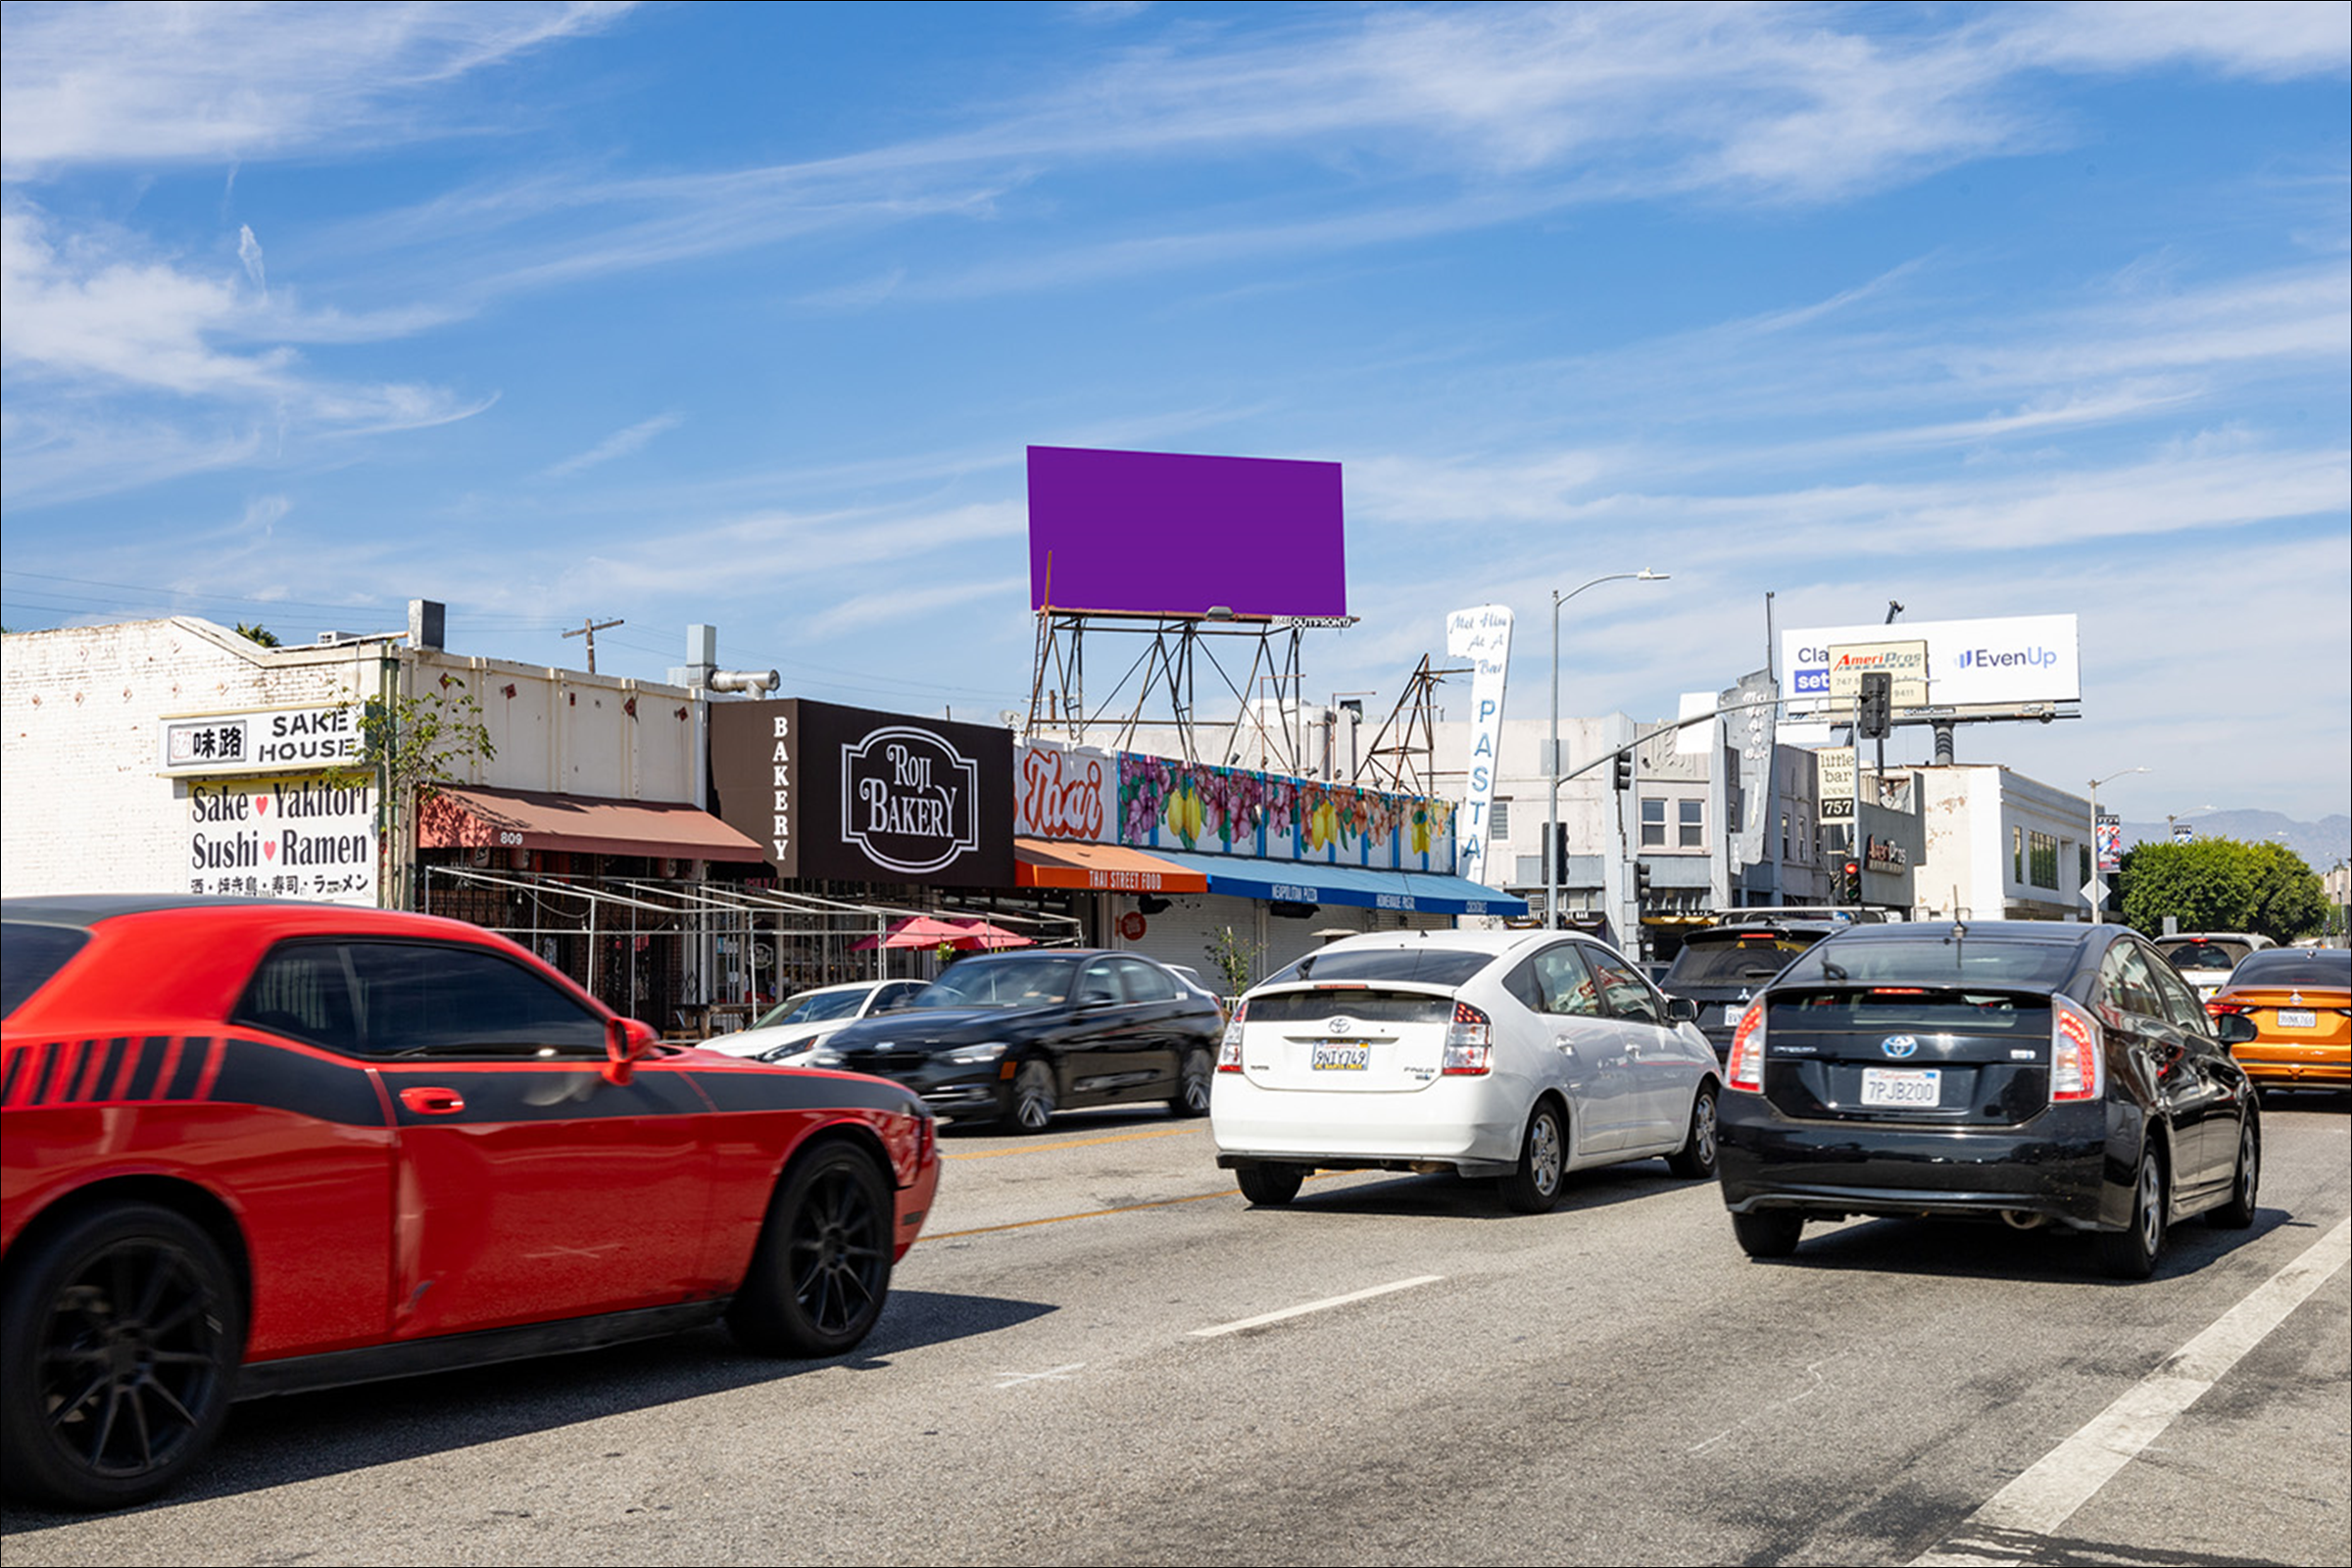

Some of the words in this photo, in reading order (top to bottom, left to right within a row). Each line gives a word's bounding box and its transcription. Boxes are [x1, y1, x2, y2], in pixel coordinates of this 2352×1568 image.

[1797, 647, 1829, 663] Cla
[1976, 646, 2057, 668] EvenUp
[1834, 651, 1922, 672] AmeriPros
[272, 710, 348, 738] SAKE
[193, 726, 242, 759] 味路
[259, 738, 355, 762] HOUSE
[1821, 753, 1855, 768] little
[1462, 699, 1495, 859] PASTA
[1824, 769, 1853, 784] bar
[772, 716, 790, 861] BAKERY
[1023, 748, 1103, 840] Thai
[192, 786, 249, 823] Sake
[273, 779, 368, 819] Yakitori
[1824, 801, 1852, 814] 757
[192, 830, 259, 870] Sushi
[282, 829, 367, 866] Ramen
[500, 832, 524, 846] 809
[1089, 870, 1108, 888] THAI
[1109, 870, 1139, 889] STREET
[1141, 872, 1162, 890] FOOD
[1316, 1050, 1367, 1065] 9NIY749
[1868, 1081, 1934, 1101] 7PJB200
